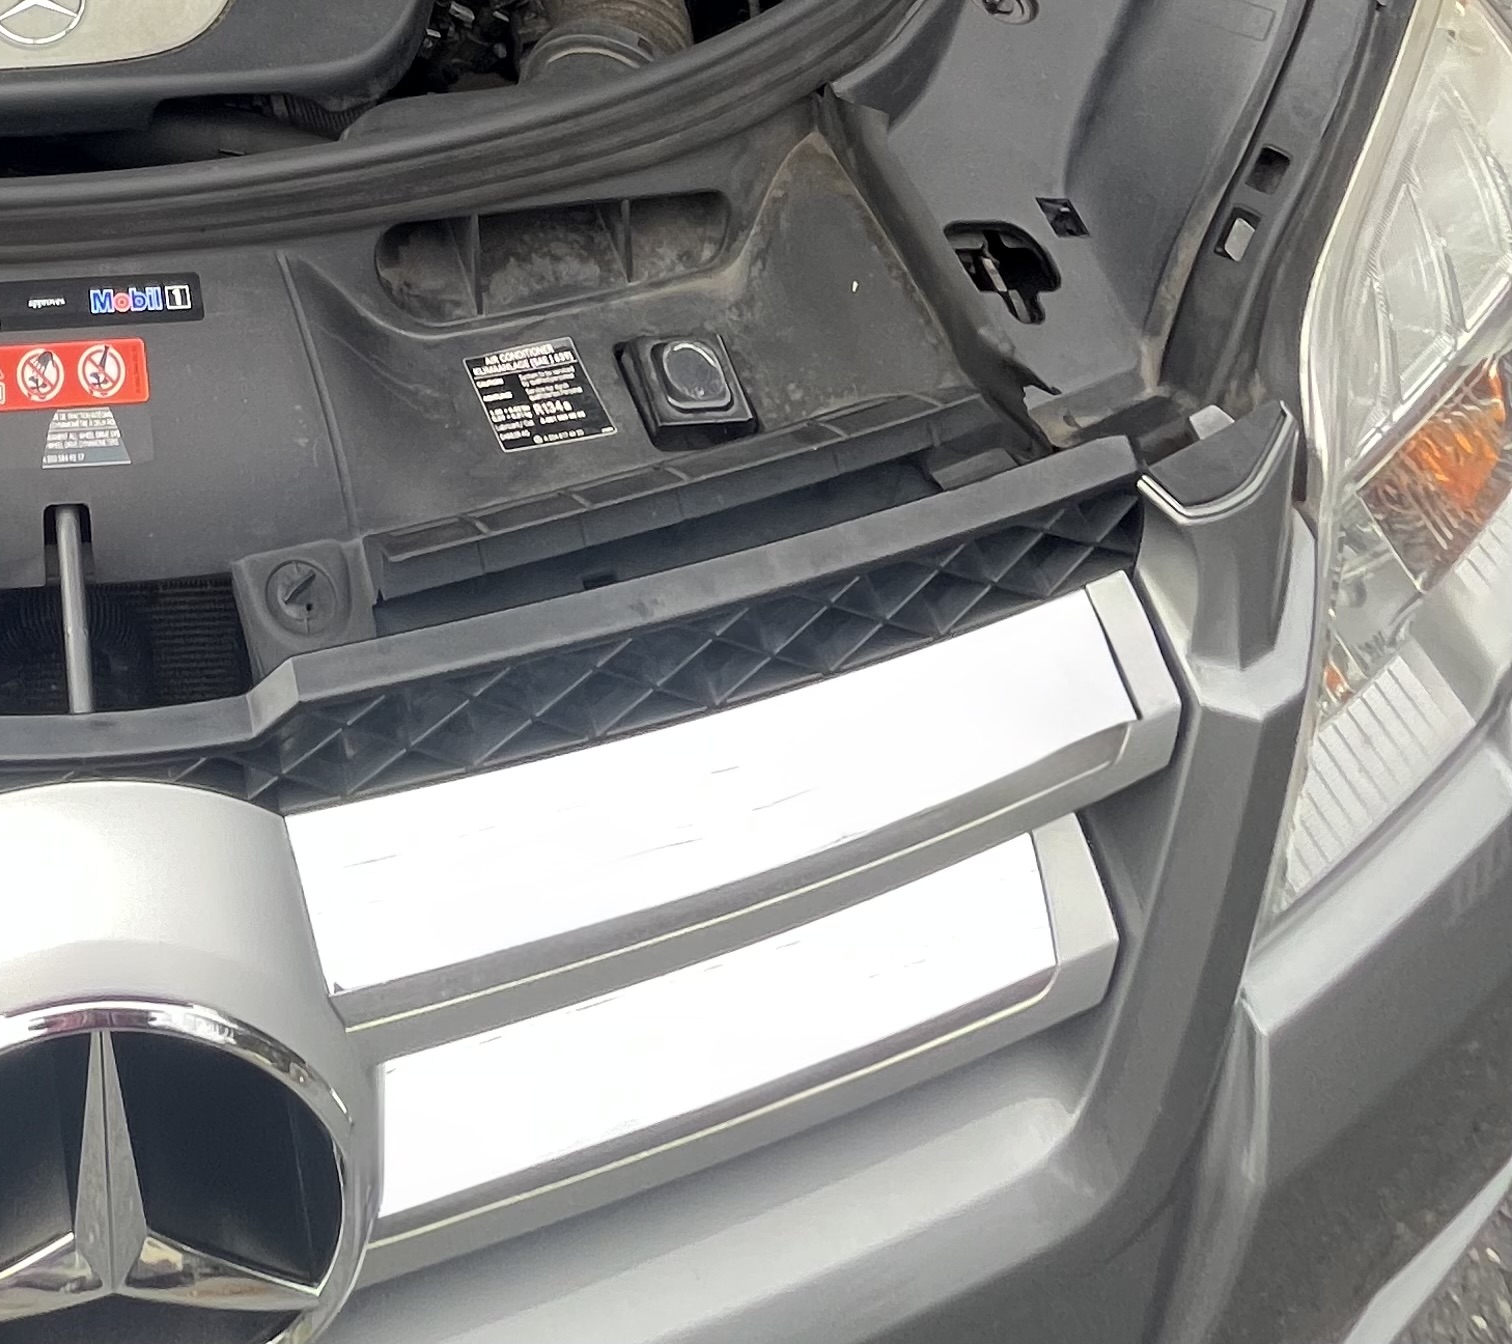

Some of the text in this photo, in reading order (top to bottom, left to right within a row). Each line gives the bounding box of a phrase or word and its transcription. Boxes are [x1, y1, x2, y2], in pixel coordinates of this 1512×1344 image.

[90, 286, 163, 313] Mobil
[485, 344, 554, 366] AIR CONDITIONER
